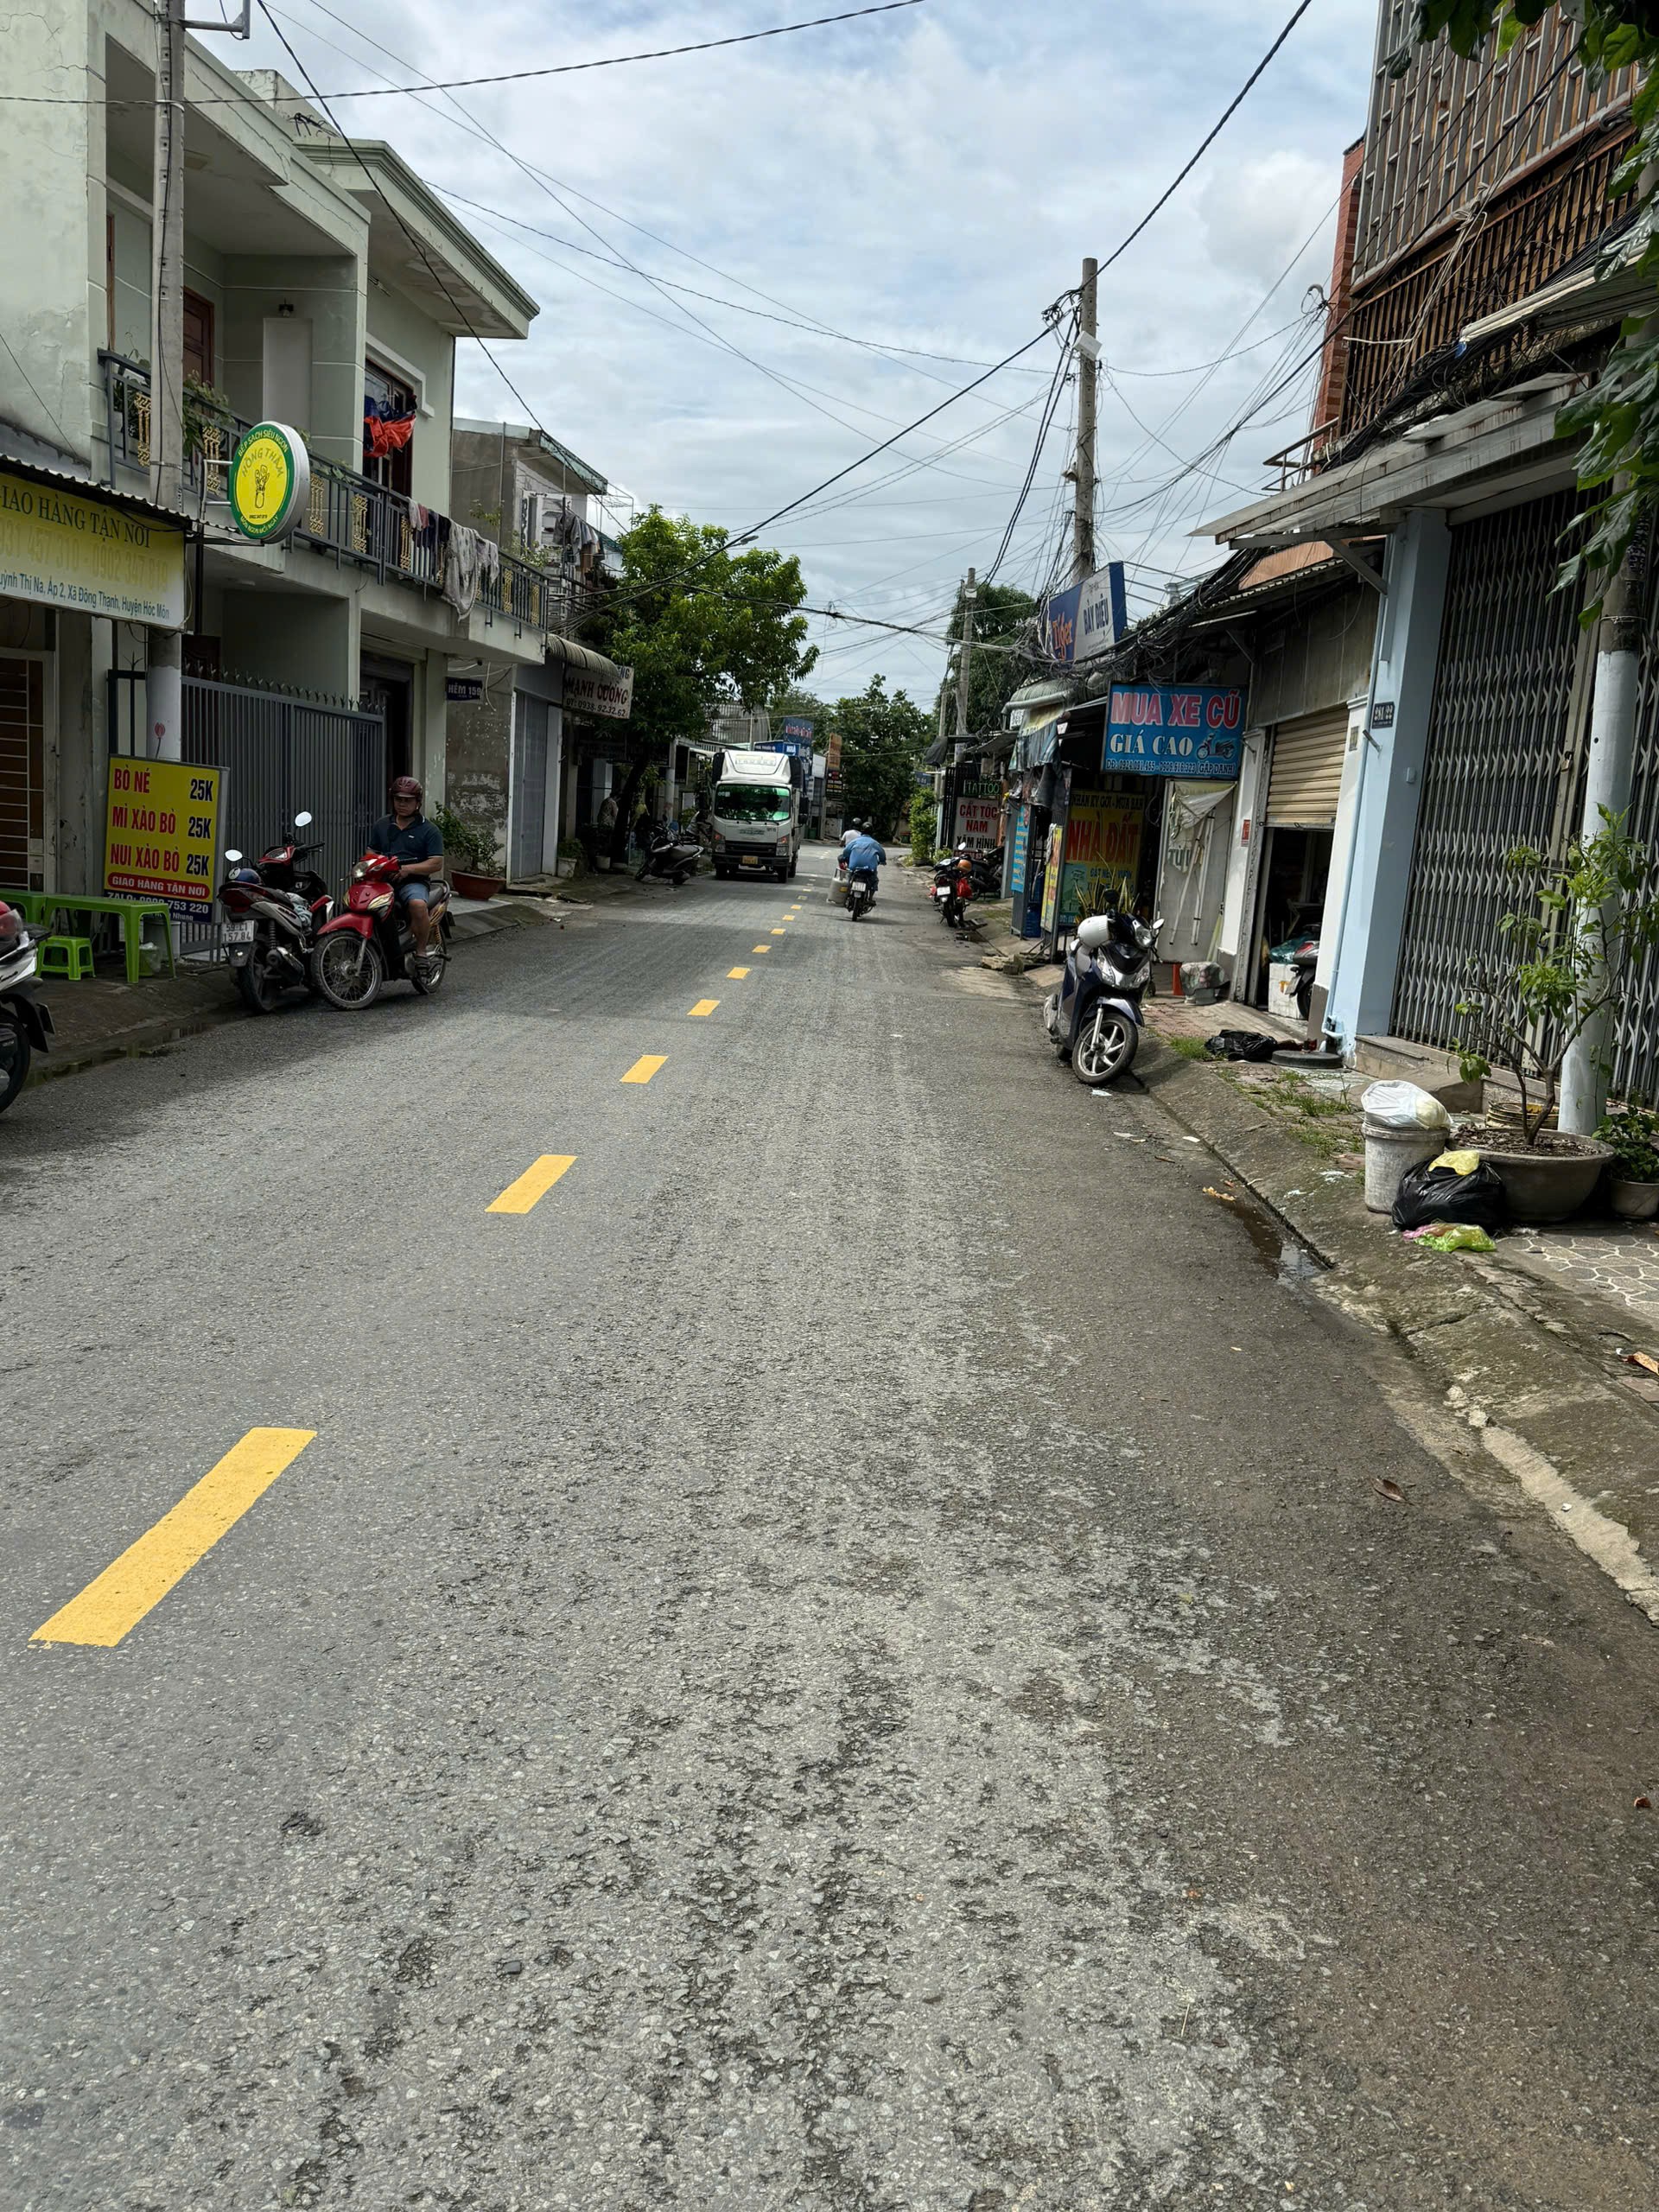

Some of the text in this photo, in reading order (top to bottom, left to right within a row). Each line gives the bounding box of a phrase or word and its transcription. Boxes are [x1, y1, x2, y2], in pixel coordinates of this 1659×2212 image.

[0, 485, 33, 514] IAO
[38, 493, 86, 530] HÀNG
[90, 509, 119, 542] TẬN
[20, 573, 32, 594] Thị
[68, 584, 77, 601] Xã
[79, 588, 97, 608] Đông
[143, 599, 156, 616] Hóc
[1110, 689, 1241, 729] MUA XE CŨ
[1110, 729, 1193, 756] GIÁ CAO
[113, 764, 213, 802] BÒ NÉ 25K
[967, 781, 1000, 795] TATTOO
[111, 804, 211, 839] MÌ XÀO BÒ 25K
[959, 801, 999, 820] CẮT TÓC
[966, 820, 988, 833] NAM
[1066, 810, 1101, 861] NHÀ
[110, 843, 209, 876] NUI XÀO BÒ 25K
[112, 875, 206, 896] GIAO HÀNG TẬN NƠI
[189, 903, 209, 914] 220
